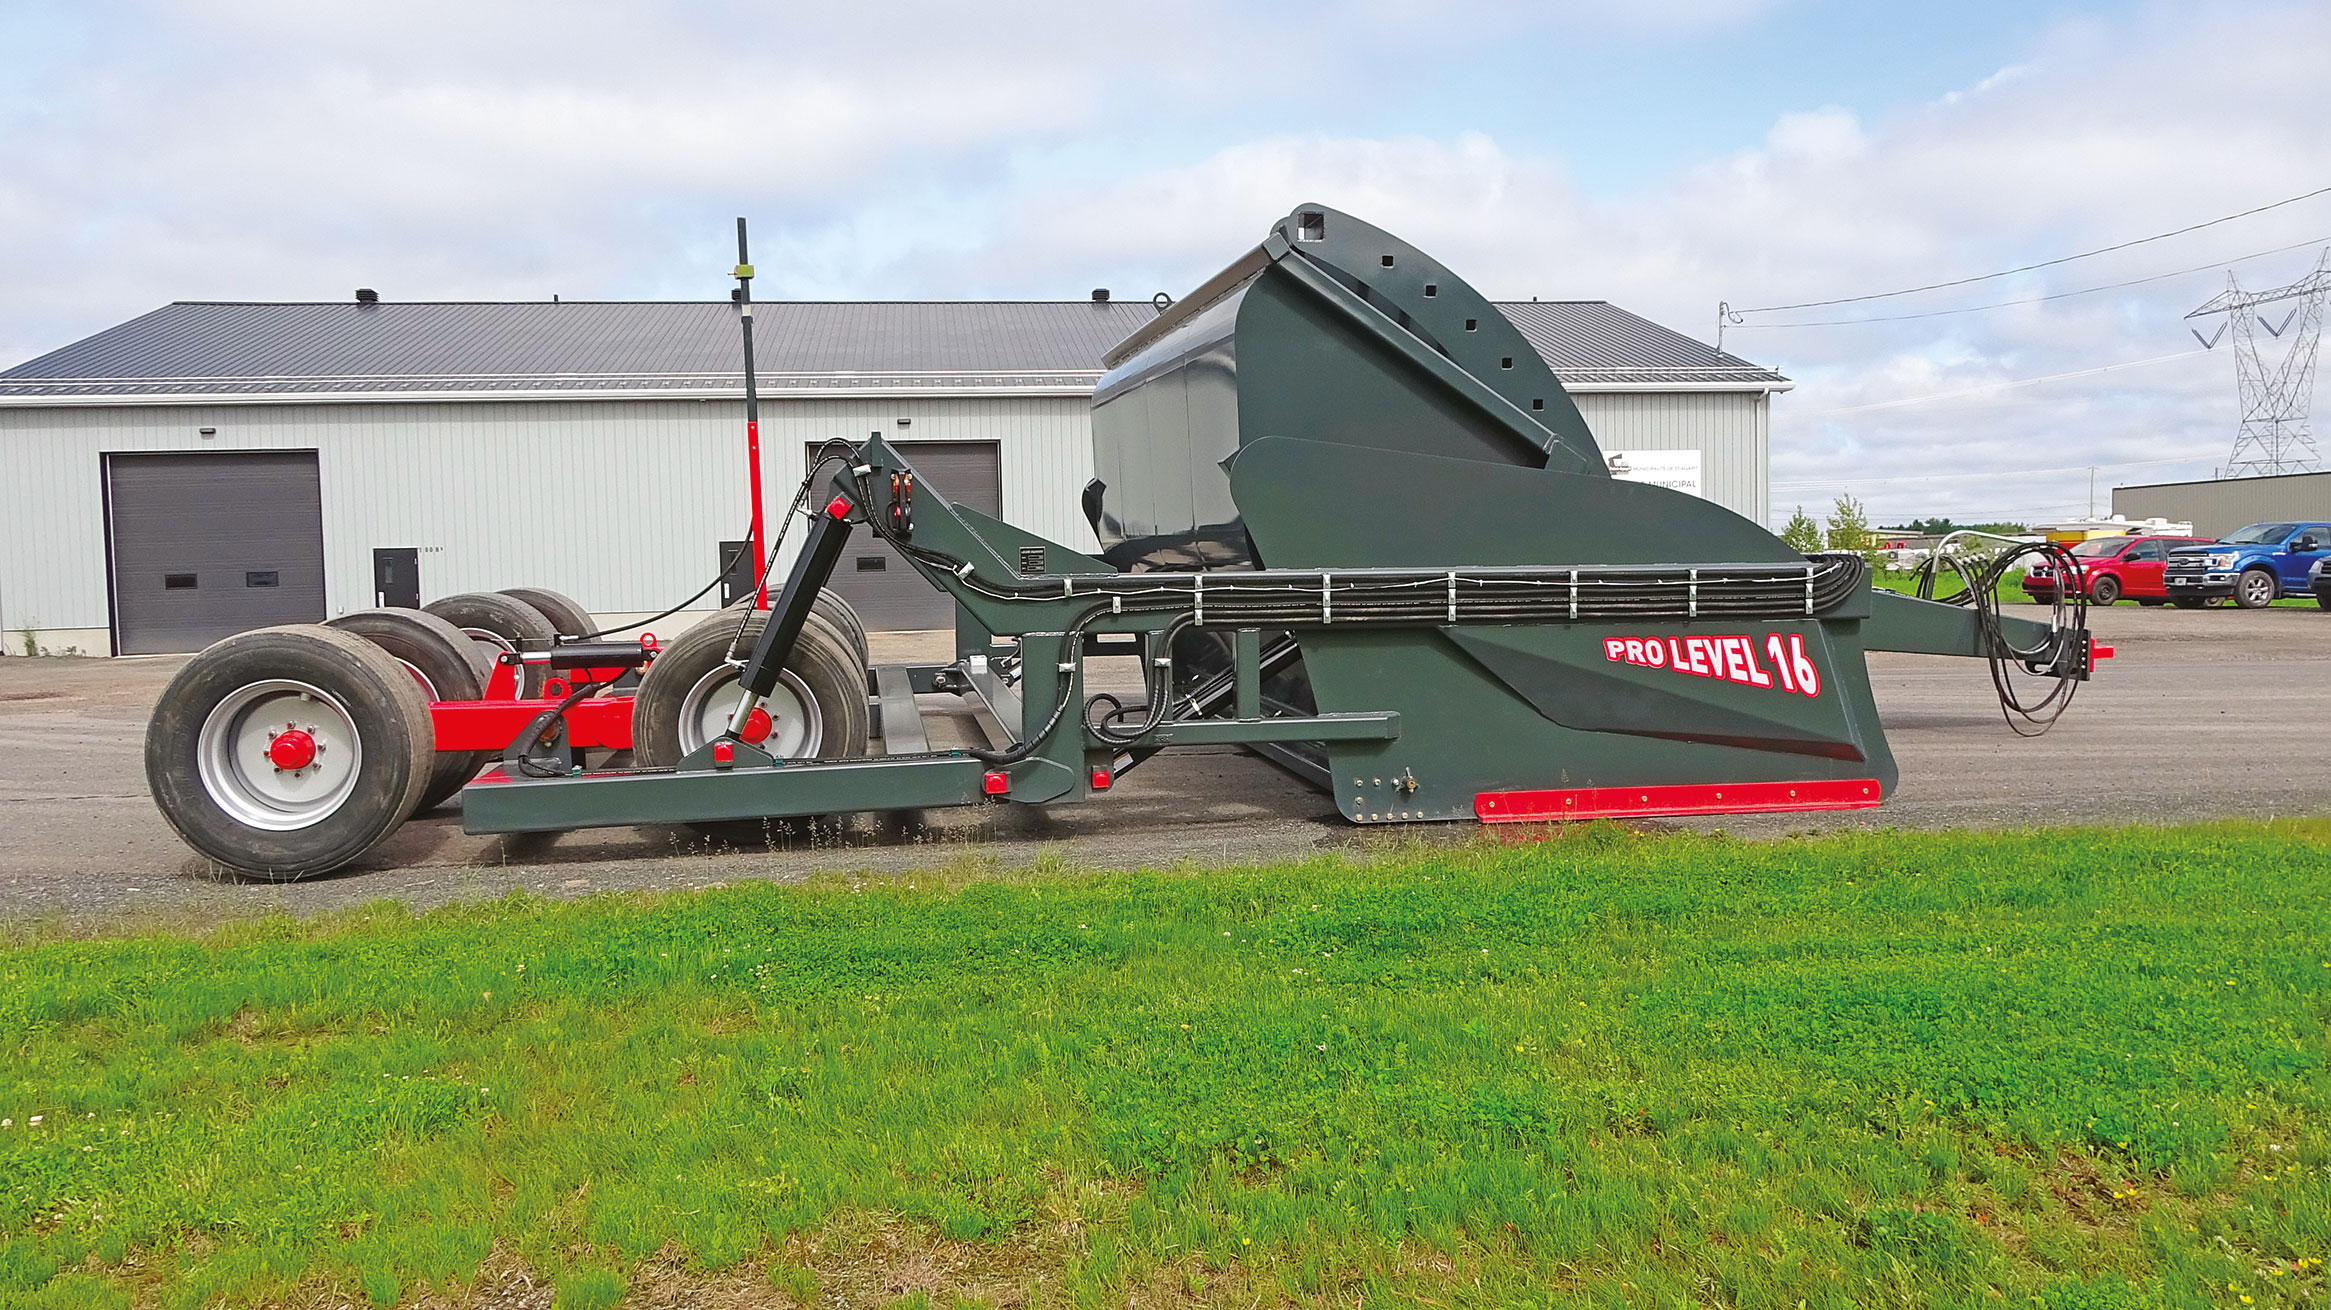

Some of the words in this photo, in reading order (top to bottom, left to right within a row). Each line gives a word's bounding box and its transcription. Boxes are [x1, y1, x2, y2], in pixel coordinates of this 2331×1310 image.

[1604, 638, 1665, 667] PRO
[1668, 637, 1771, 687] LEVEL
[1767, 634, 1818, 696] 16
